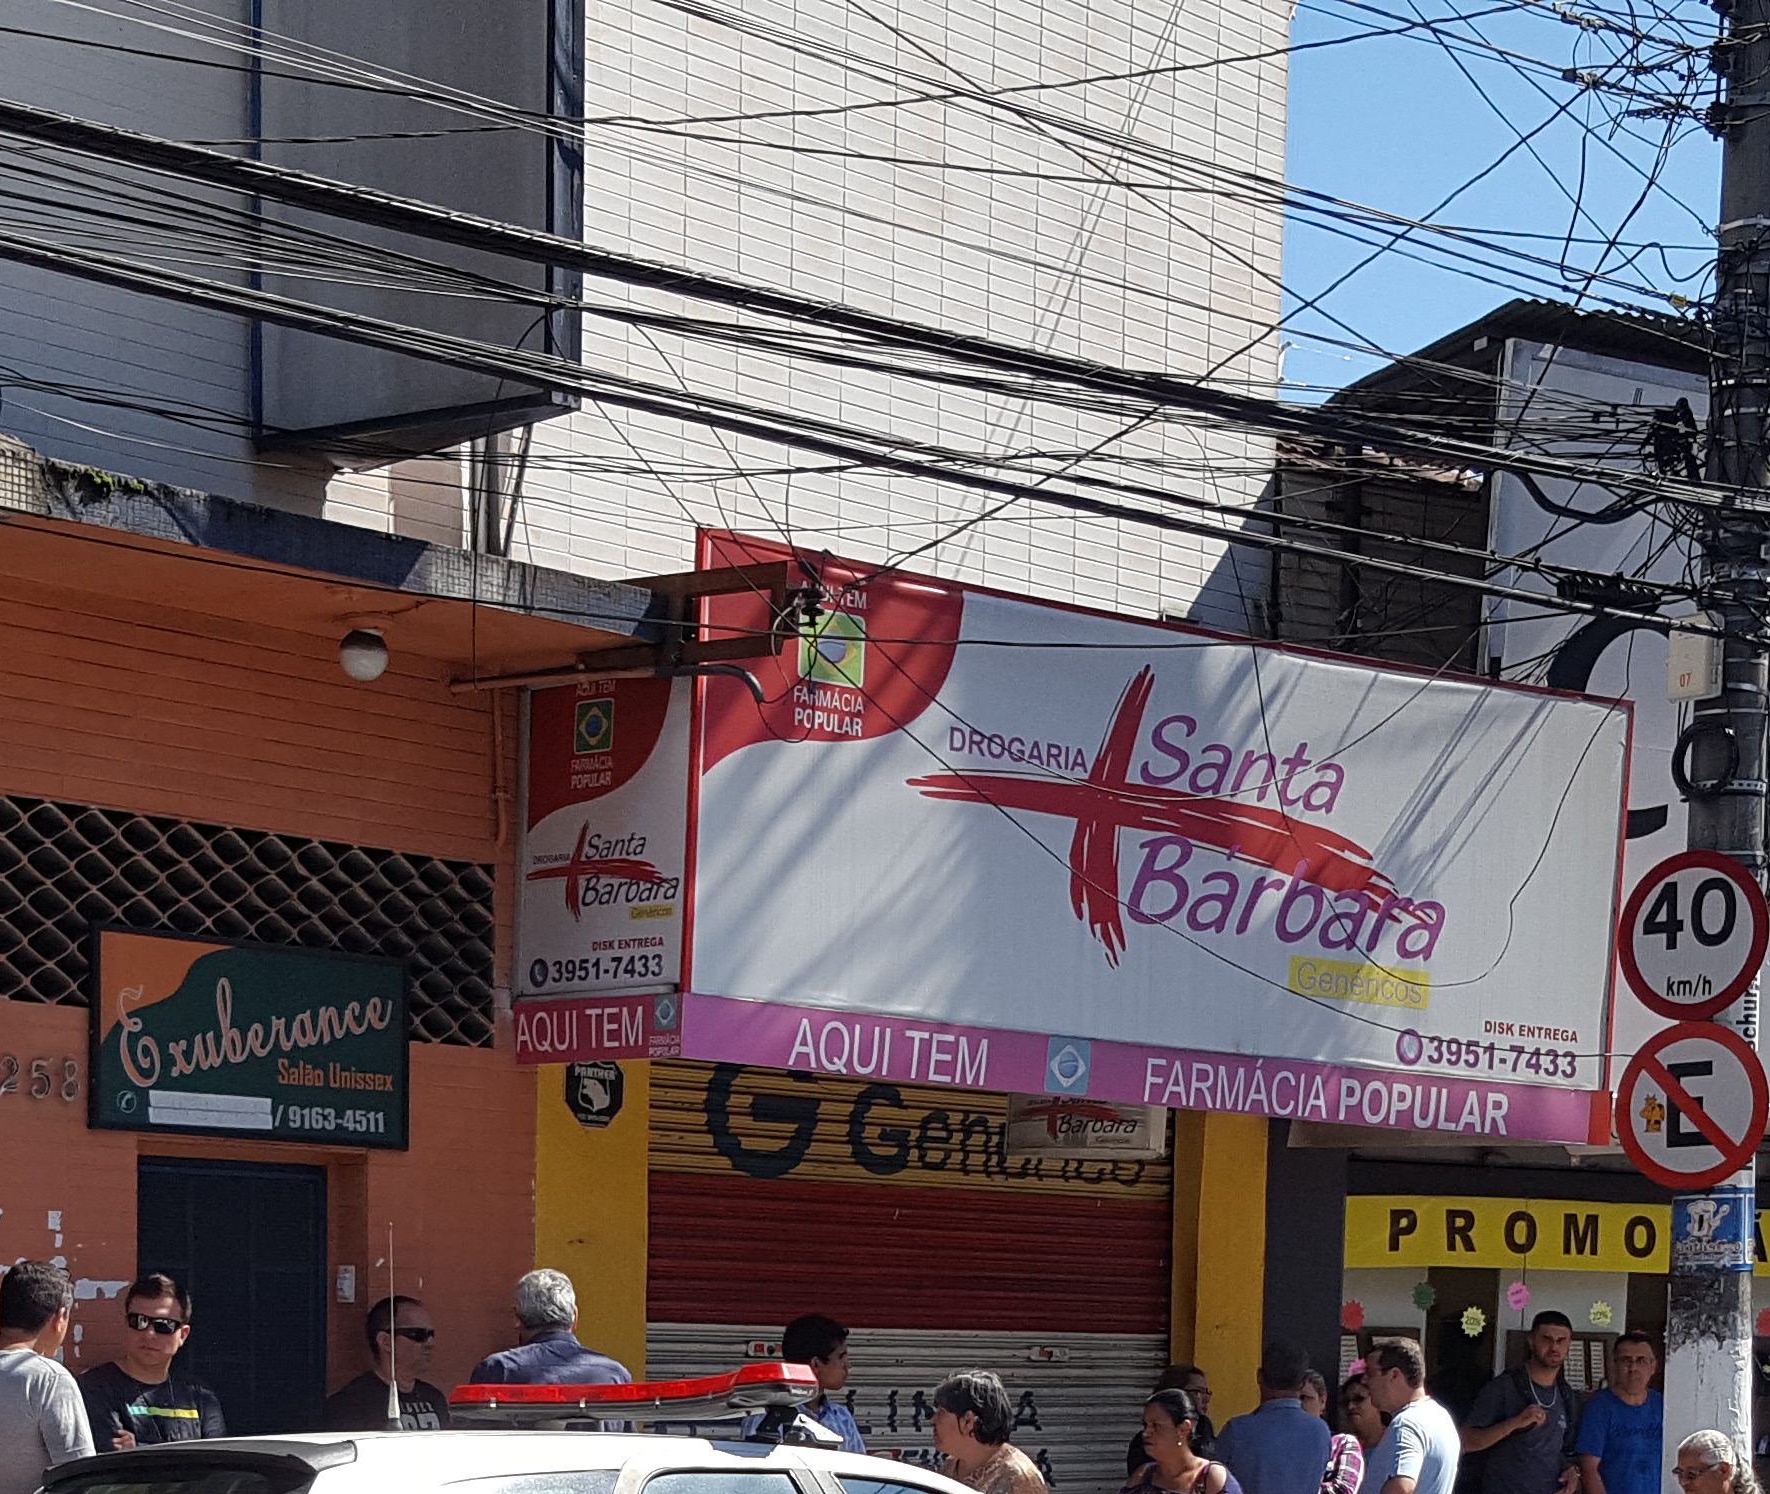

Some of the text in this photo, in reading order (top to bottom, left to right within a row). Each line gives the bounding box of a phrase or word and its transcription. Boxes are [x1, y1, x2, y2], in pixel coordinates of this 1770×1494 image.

[1679, 672, 1692, 688] 07
[793, 684, 865, 715] FARMÁCIA
[794, 706, 863, 737] POPULAR
[570, 771, 613, 789] POPULAR
[949, 715, 1345, 815] DROGARIA Santa
[584, 831, 647, 860] Santa
[1127, 835, 1446, 961] Bárbara
[1642, 877, 1737, 951] 40
[592, 936, 665, 951] DISK ENTREGA
[550, 953, 664, 983] 3951-7433
[1296, 961, 1423, 1004] Genéricos
[1666, 974, 1713, 998] km/h
[116, 976, 393, 1088] Exuberance
[516, 1006, 644, 1053] AQUI TEM
[1484, 1019, 1579, 1044] DISK ENTREGA
[574, 1065, 617, 1081] PANTHER
[1427, 1036, 1578, 1079] 3951-7433
[276, 1057, 396, 1092] Salão Unissex
[788, 1017, 1510, 1136] AQUI TEM FARMÁCIA POPULAR
[287, 1105, 386, 1134] 9163-4511
[1666, 1060, 1714, 1148] E
